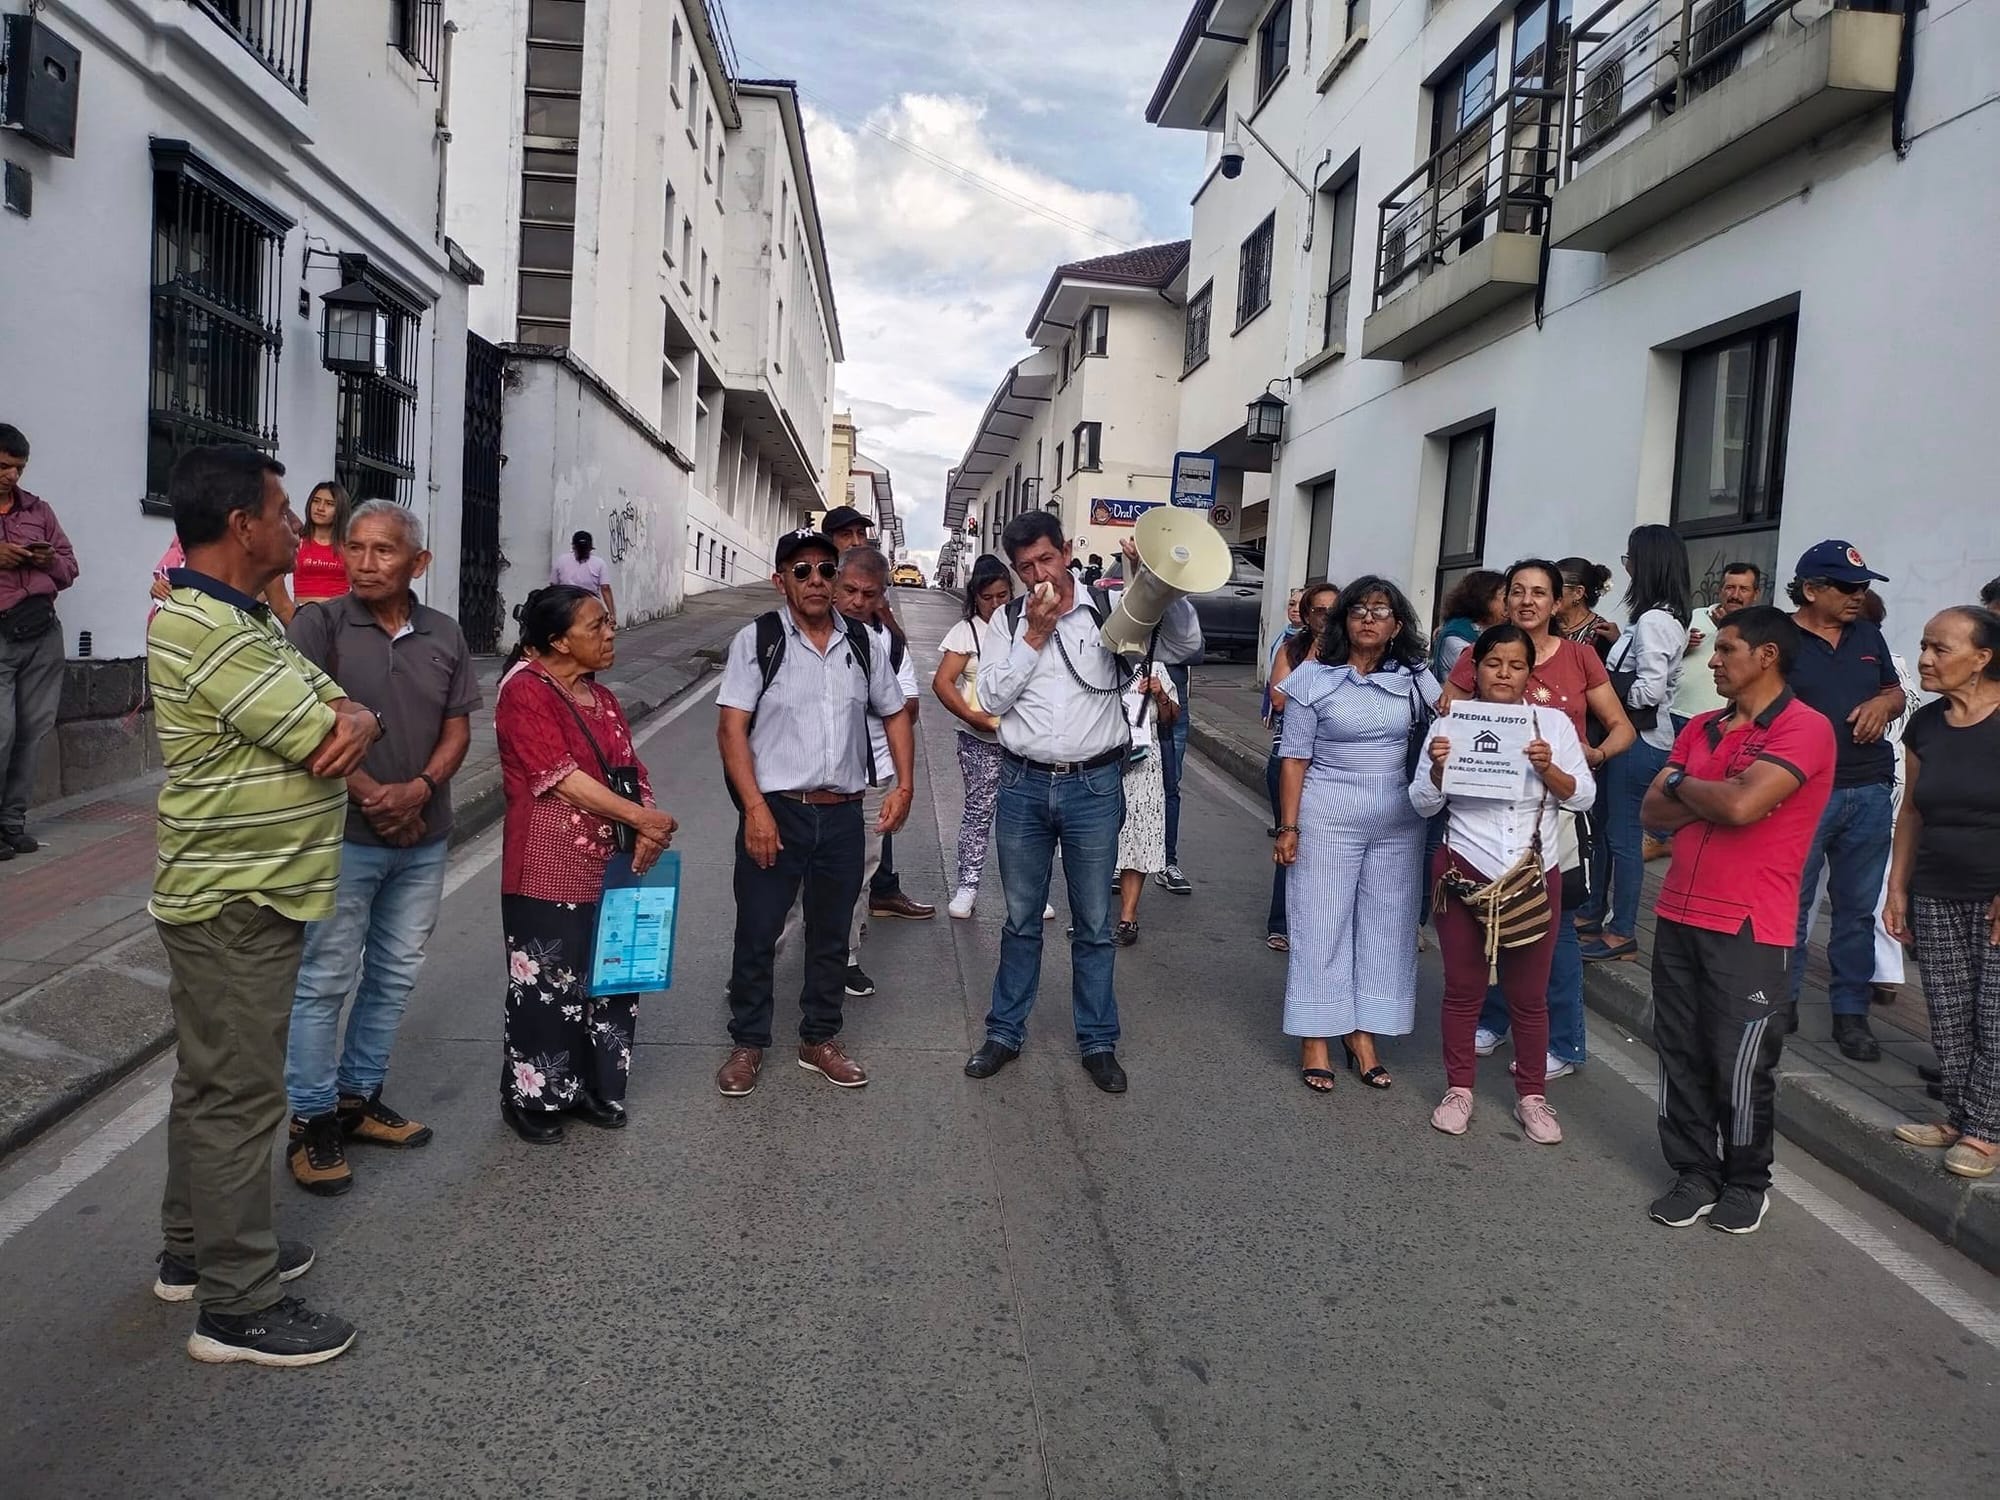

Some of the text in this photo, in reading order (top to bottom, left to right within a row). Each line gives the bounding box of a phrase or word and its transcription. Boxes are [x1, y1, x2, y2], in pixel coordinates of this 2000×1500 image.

[1452, 712, 1527, 725] PREDIAL JUSTO
[245, 1327, 267, 1336] FILA
